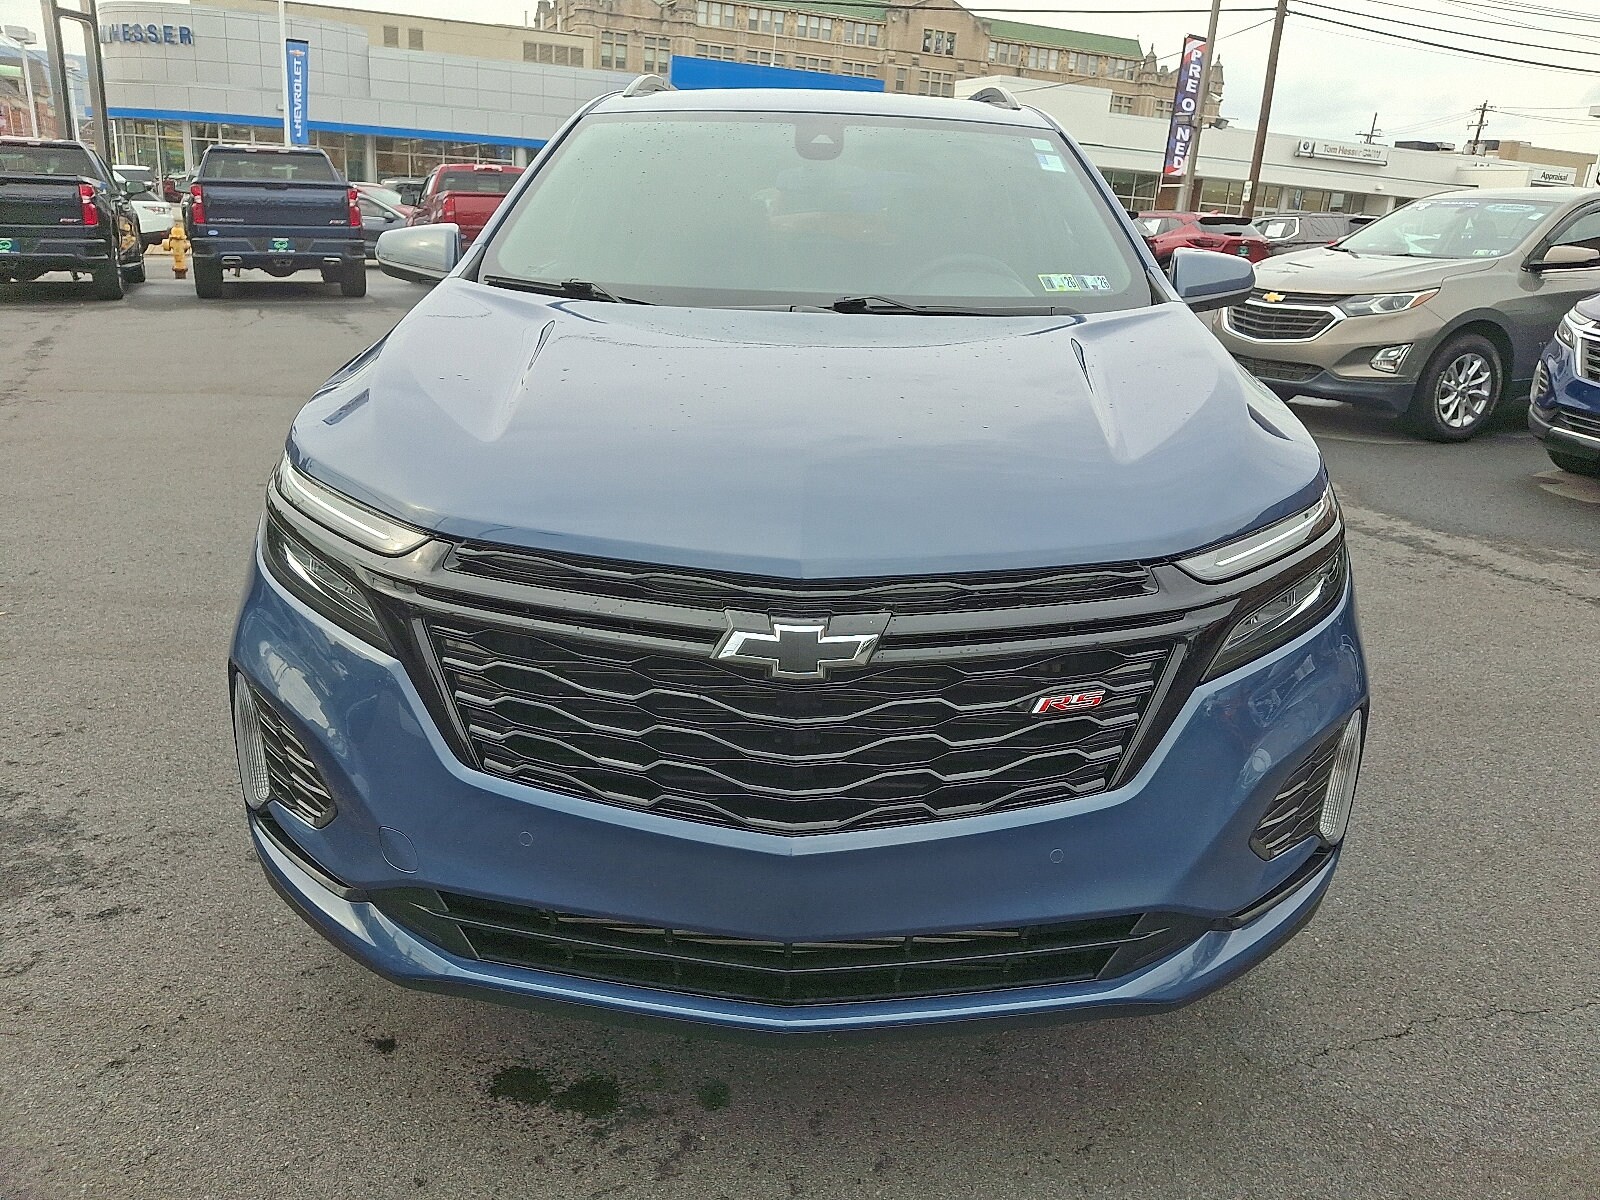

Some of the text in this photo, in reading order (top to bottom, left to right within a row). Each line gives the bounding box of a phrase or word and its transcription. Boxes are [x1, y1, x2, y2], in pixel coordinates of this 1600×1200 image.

[112, 23, 192, 44] HESSER
[293, 57, 302, 138] CHEVROLET
[1173, 49, 1203, 169] PRE ONED
[1324, 144, 1338, 154] Tom
[1541, 171, 1569, 182] Appraisal
[1031, 690, 1106, 713] RS
